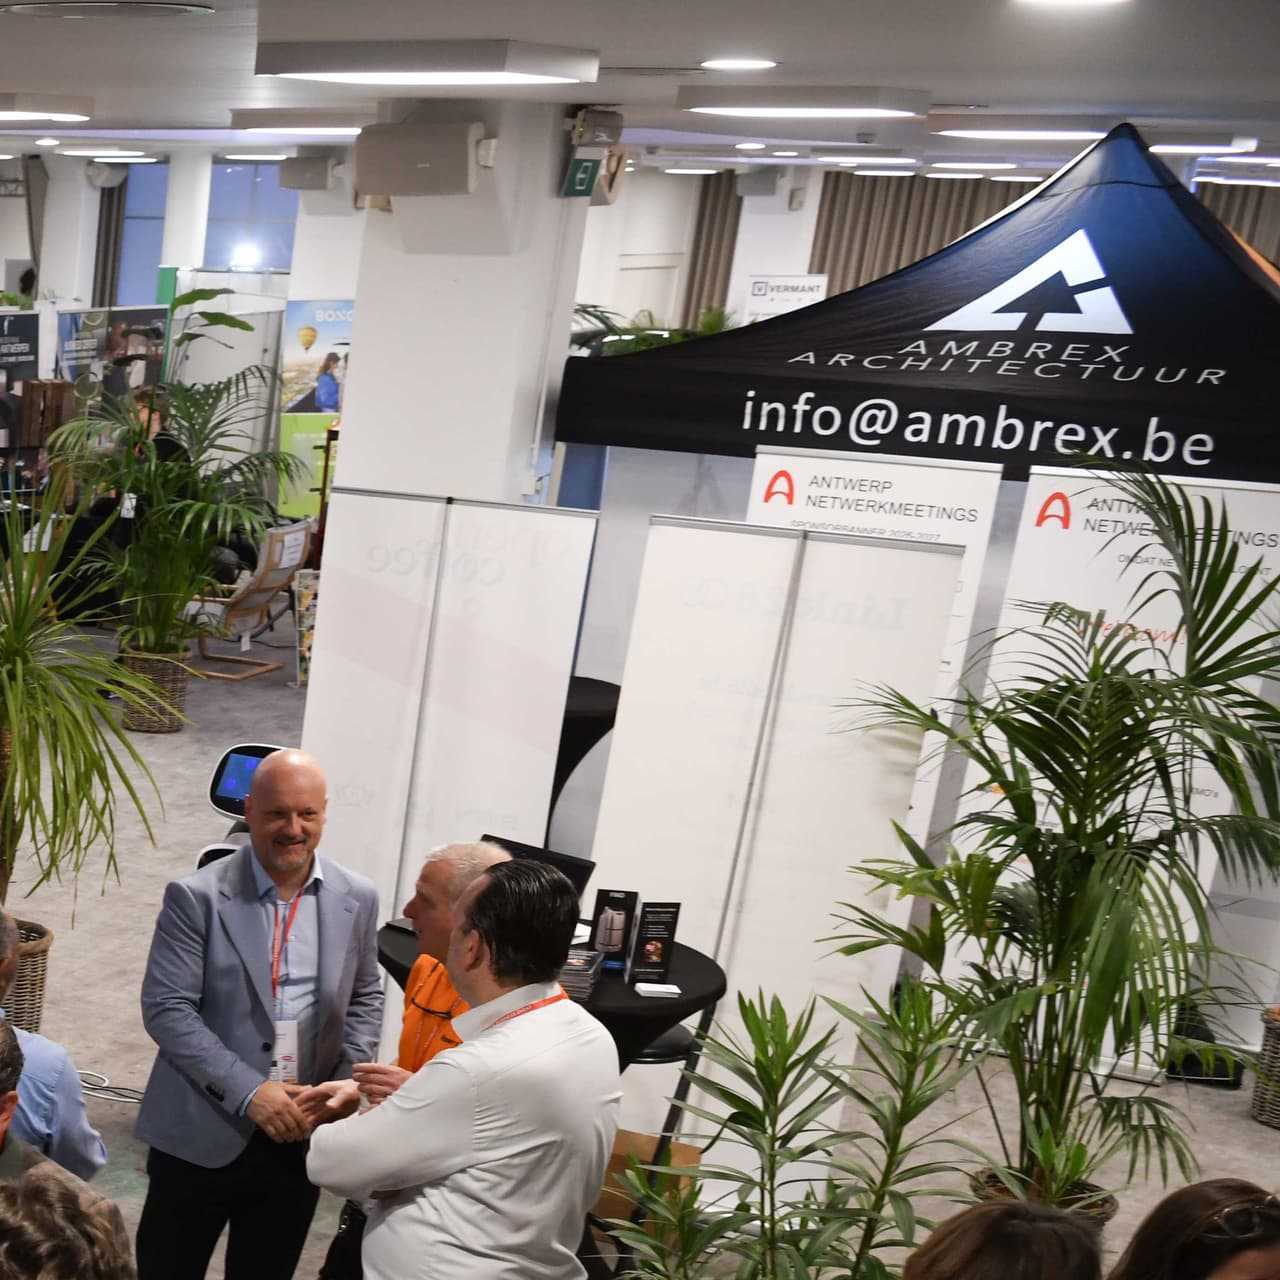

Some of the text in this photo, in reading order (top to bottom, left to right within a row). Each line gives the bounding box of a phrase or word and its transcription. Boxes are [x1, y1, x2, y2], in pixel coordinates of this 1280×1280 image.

[769, 281, 821, 294] VERMANT
[897, 339, 1130, 364] AMBREX
[787, 351, 1228, 386] ARCHITECTUUR
[741, 389, 1216, 466] info@ambrex.be
[808, 475, 893, 494] ANTWERP
[806, 494, 979, 523] NETWERKMEETINGS
